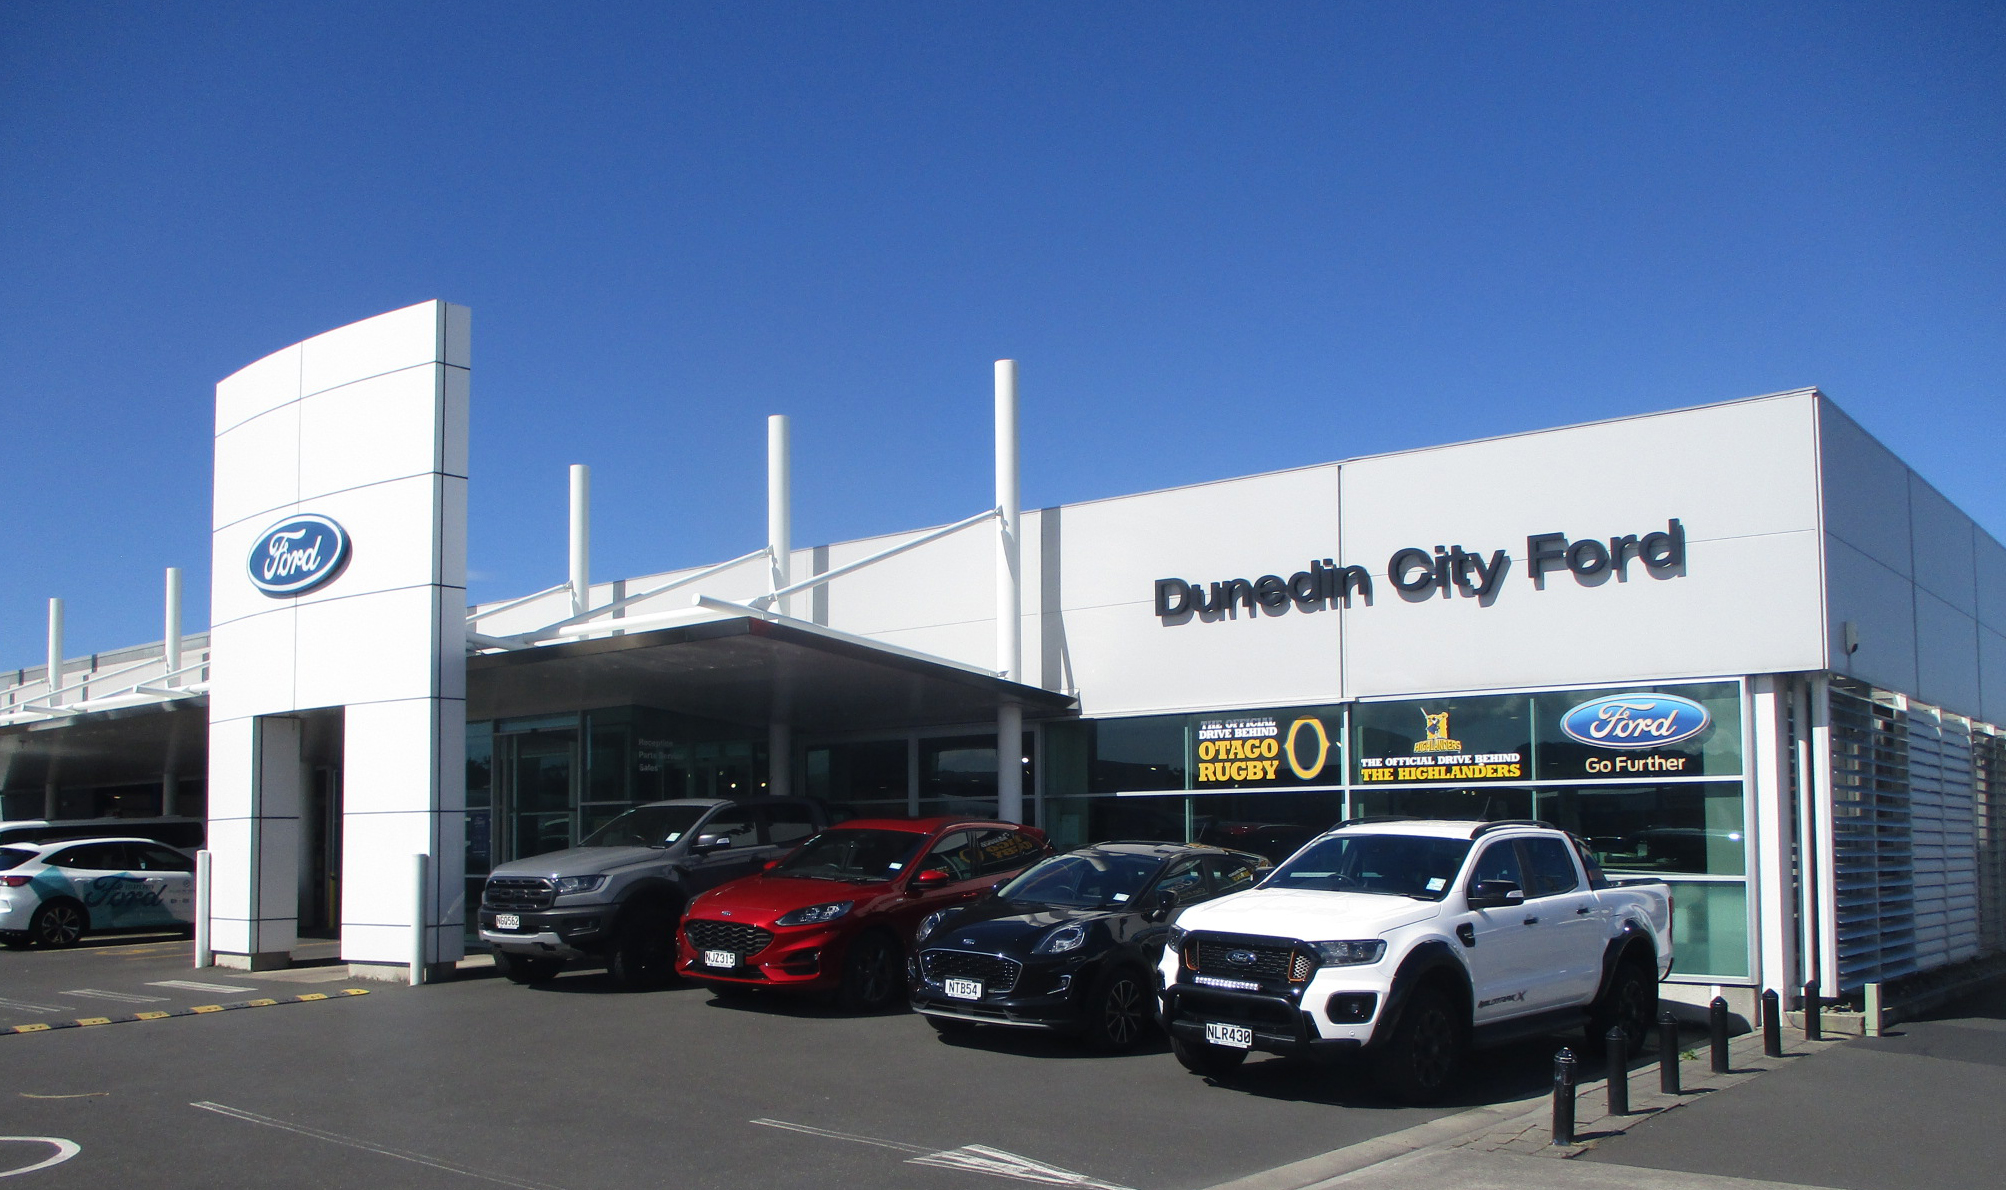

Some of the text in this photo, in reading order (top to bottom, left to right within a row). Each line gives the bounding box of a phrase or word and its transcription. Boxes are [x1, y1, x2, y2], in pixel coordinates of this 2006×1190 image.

[264, 528, 322, 580] Ford
[1155, 518, 1685, 620] Dunedin City Ford
[1201, 716, 1276, 730] THE OFFICIAL
[1589, 702, 1679, 739] Ford
[1199, 726, 1278, 739] DRIVE BEHIND
[1198, 738, 1279, 760] OTAGO
[1414, 739, 1462, 753] HIGHLANDERS
[1361, 753, 1520, 768] THE OFFICIAL DRIVE BEHIND
[1585, 755, 1686, 773] Go Further
[1198, 760, 1279, 782] RUGBY
[1361, 763, 1521, 782] THE HIGHLANDERS
[84, 875, 168, 908] Ford
[705, 952, 735, 964] NJZ315
[948, 981, 978, 996] NTB54
[1207, 1024, 1251, 1044] NLR430
